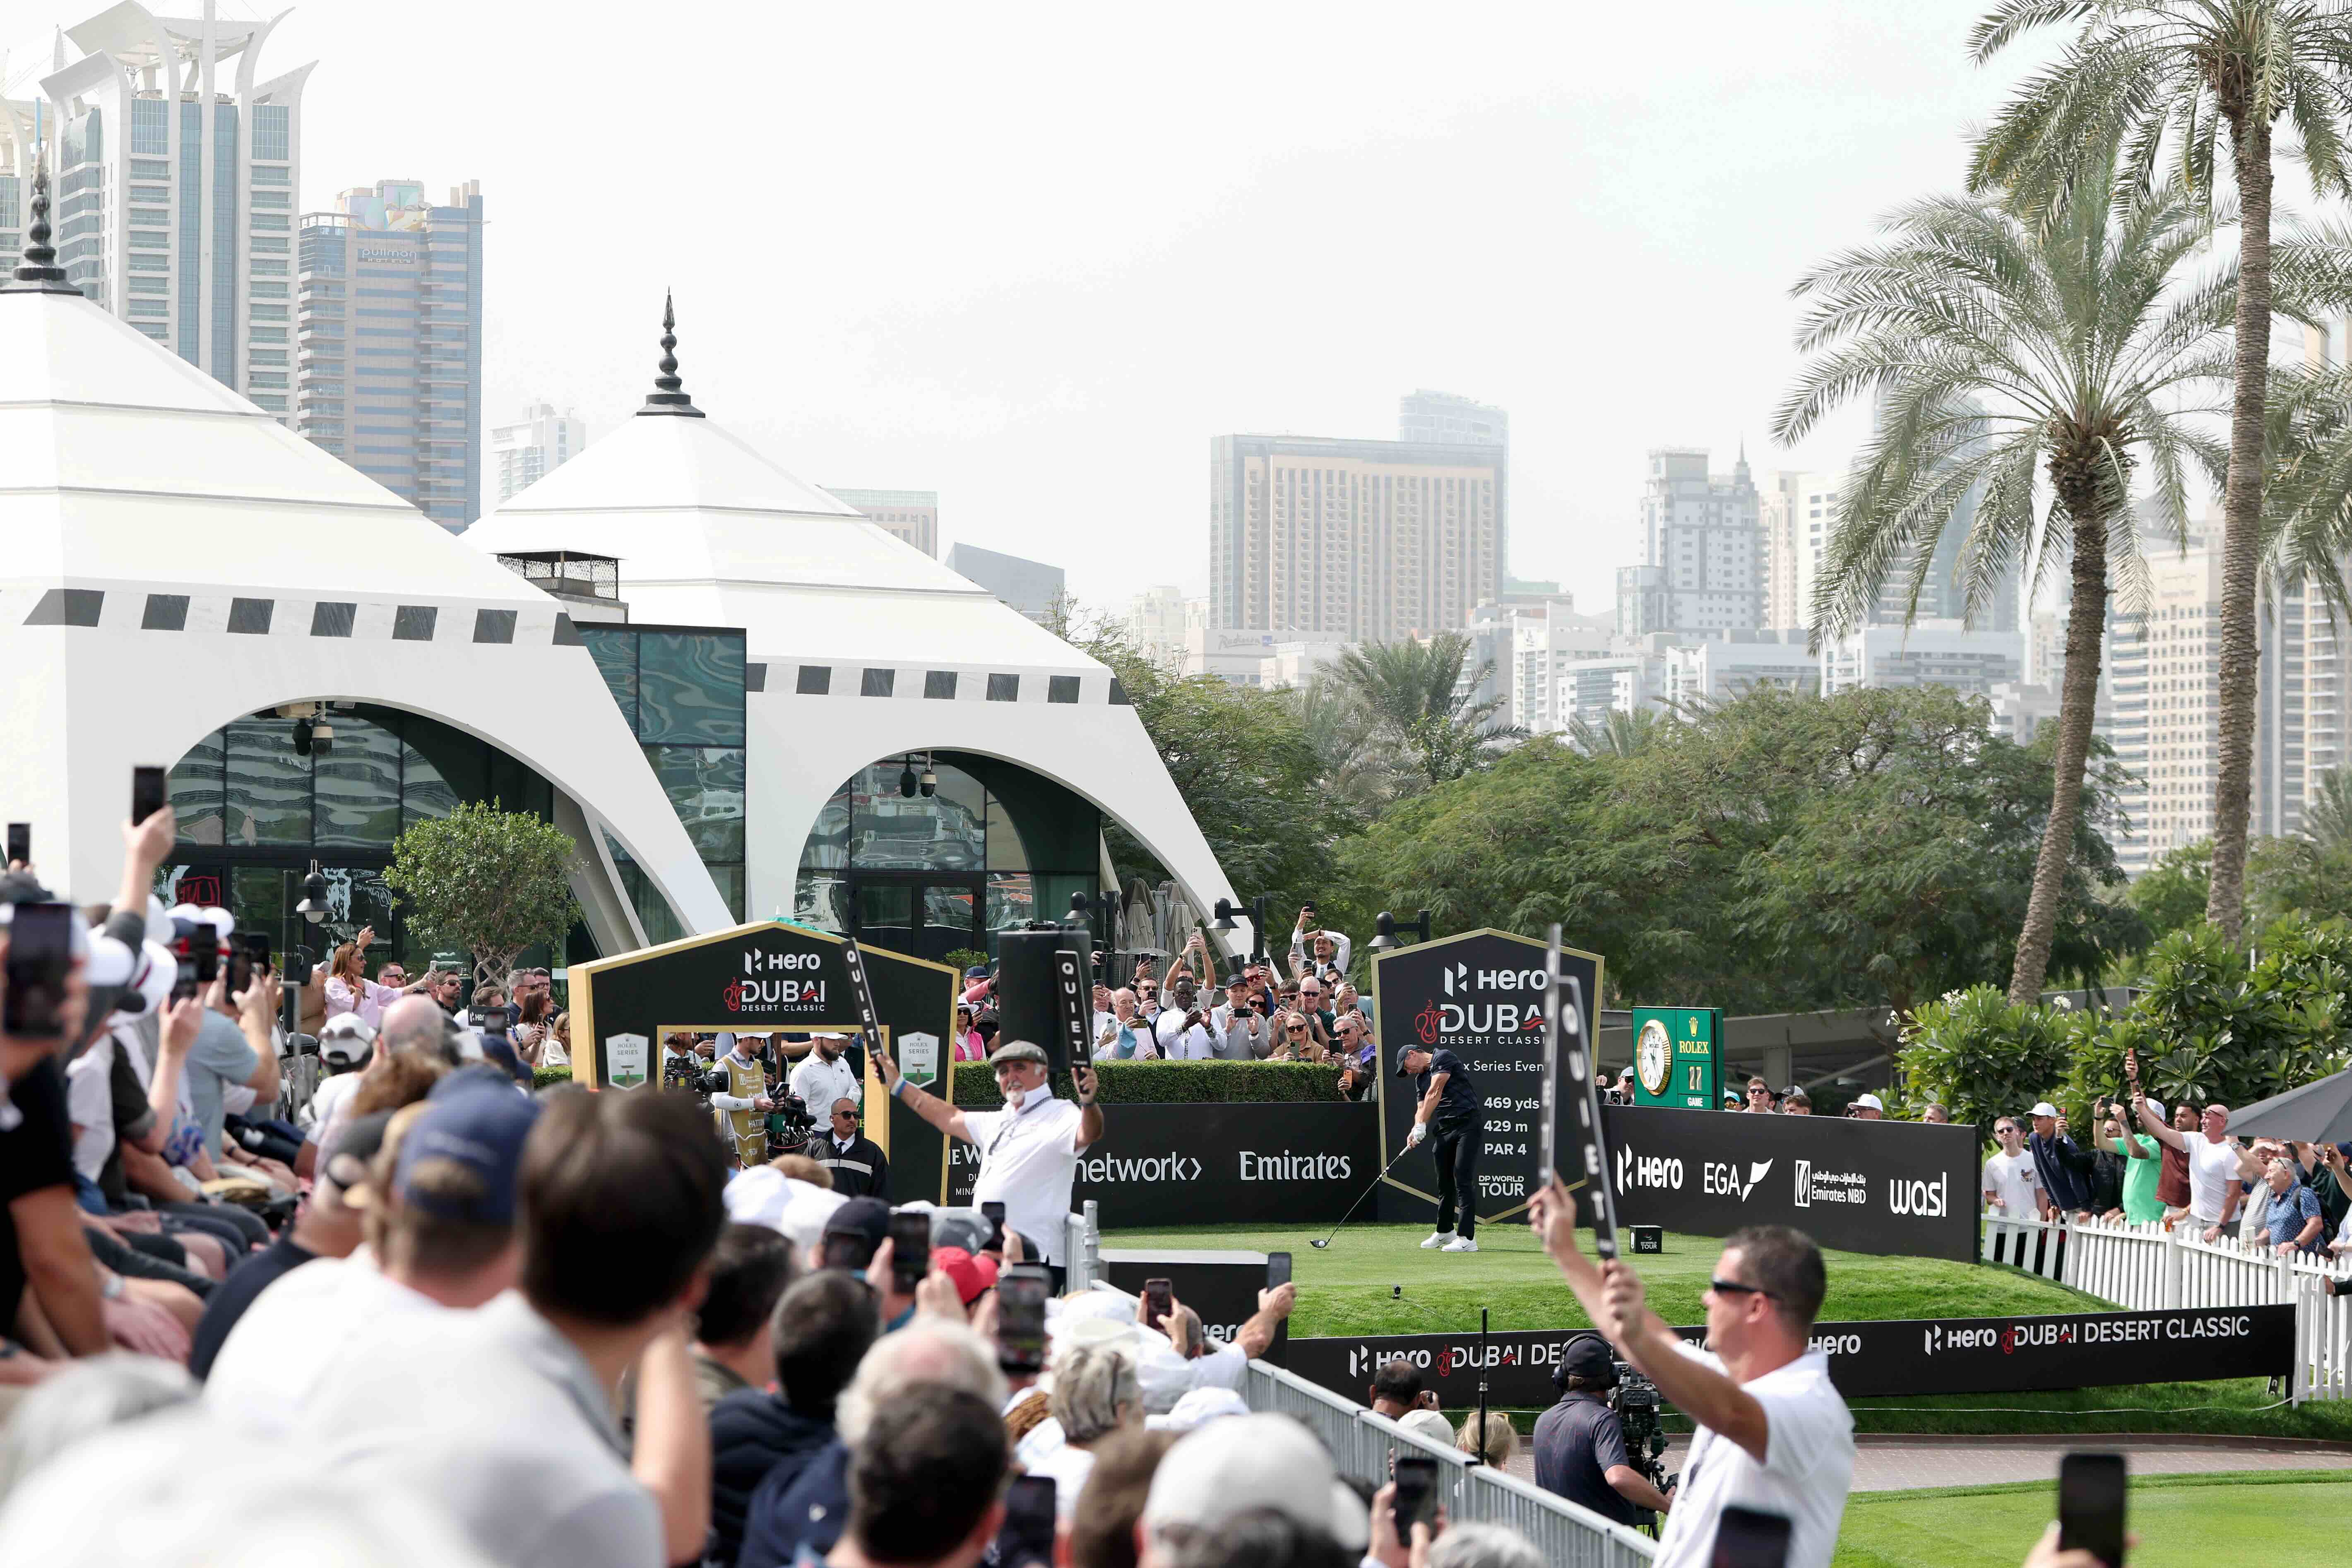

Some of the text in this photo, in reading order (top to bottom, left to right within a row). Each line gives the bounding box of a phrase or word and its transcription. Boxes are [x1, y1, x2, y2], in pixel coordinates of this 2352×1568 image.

[361, 248, 417, 261] pullman
[769, 954, 820, 969] Hero
[1478, 969, 1549, 990] Hero
[741, 981, 825, 1002] DUBAI
[847, 950, 874, 1041] QUIET
[1062, 962, 1083, 1052] QUIET
[1440, 1004, 1547, 1032] DUBA
[1498, 1036, 1545, 1044] CLASSI
[1679, 1040, 1709, 1053] ROLEX
[1474, 1061, 1510, 1072] Series
[1515, 1061, 1544, 1071] Even
[1689, 1066, 1702, 1090] 27
[1484, 1097, 1539, 1111] 469 yds
[1562, 1003, 1605, 1221] QUIET
[1687, 1097, 1703, 1106] GAME
[1484, 1120, 1527, 1132] 429 m
[1485, 1143, 1527, 1155] PAR 4
[1239, 1150, 1351, 1180] Emirates
[1638, 1156, 1683, 1189] Hero
[1704, 1162, 1741, 1196] EGA
[1479, 1183, 1525, 1198] TOUR
[1811, 1185, 1866, 1204] Emirates NBD
[1890, 1171, 1947, 1217] wasl
[1948, 1315, 2250, 1348] Hero DUBAI DESERT CLASSIC
[1808, 1335, 1861, 1355] Hero
[1452, 1344, 1522, 1368] DUBAI
